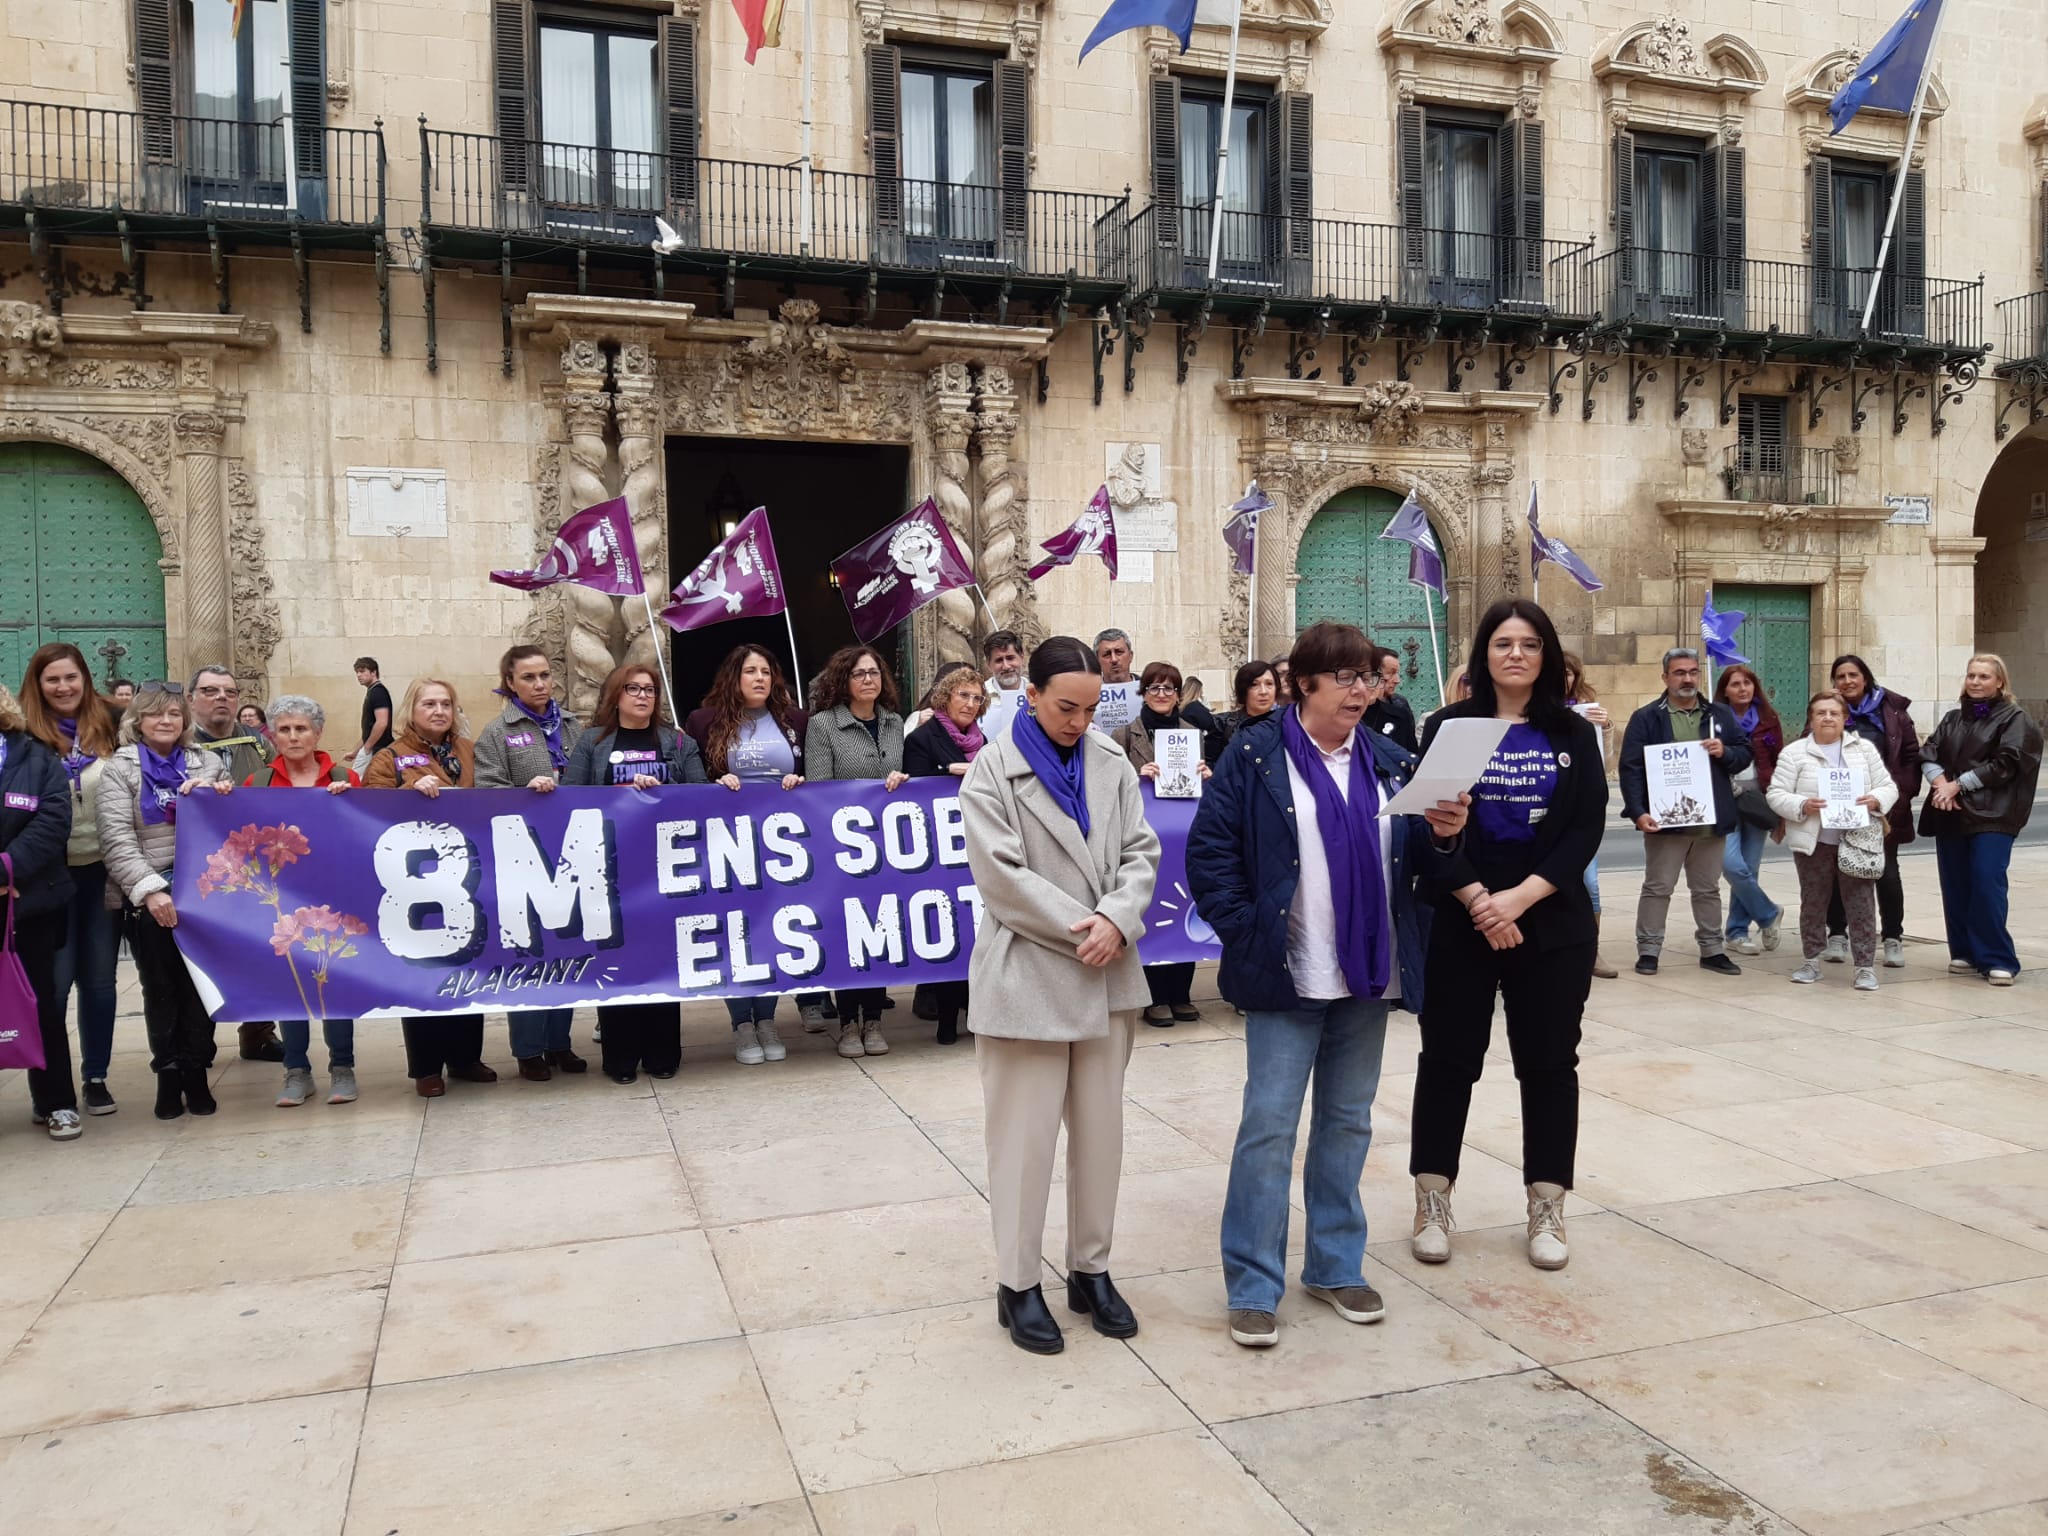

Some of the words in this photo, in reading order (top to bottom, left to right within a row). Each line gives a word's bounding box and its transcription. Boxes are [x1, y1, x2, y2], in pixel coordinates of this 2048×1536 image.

[1016, 694, 1026, 707] 8
[1100, 688, 1126, 702] 8M
[508, 736, 524, 746] UGT
[1168, 734, 1188, 745] 8M
[1503, 749, 1540, 761] puede
[1541, 751, 1554, 759] se
[1662, 746, 1689, 761] 8M
[398, 756, 416, 767] UGT
[1520, 762, 1540, 772] sin
[1543, 764, 1557, 772] se
[613, 761, 671, 784] FEMINIST
[1830, 771, 1850, 780] 8M
[9, 795, 30, 806] UGT
[656, 811, 809, 895] ENS
[831, 797, 969, 875] SOB
[373, 808, 614, 960] 8M
[675, 904, 821, 989] ELS
[843, 884, 985, 968] MOT
